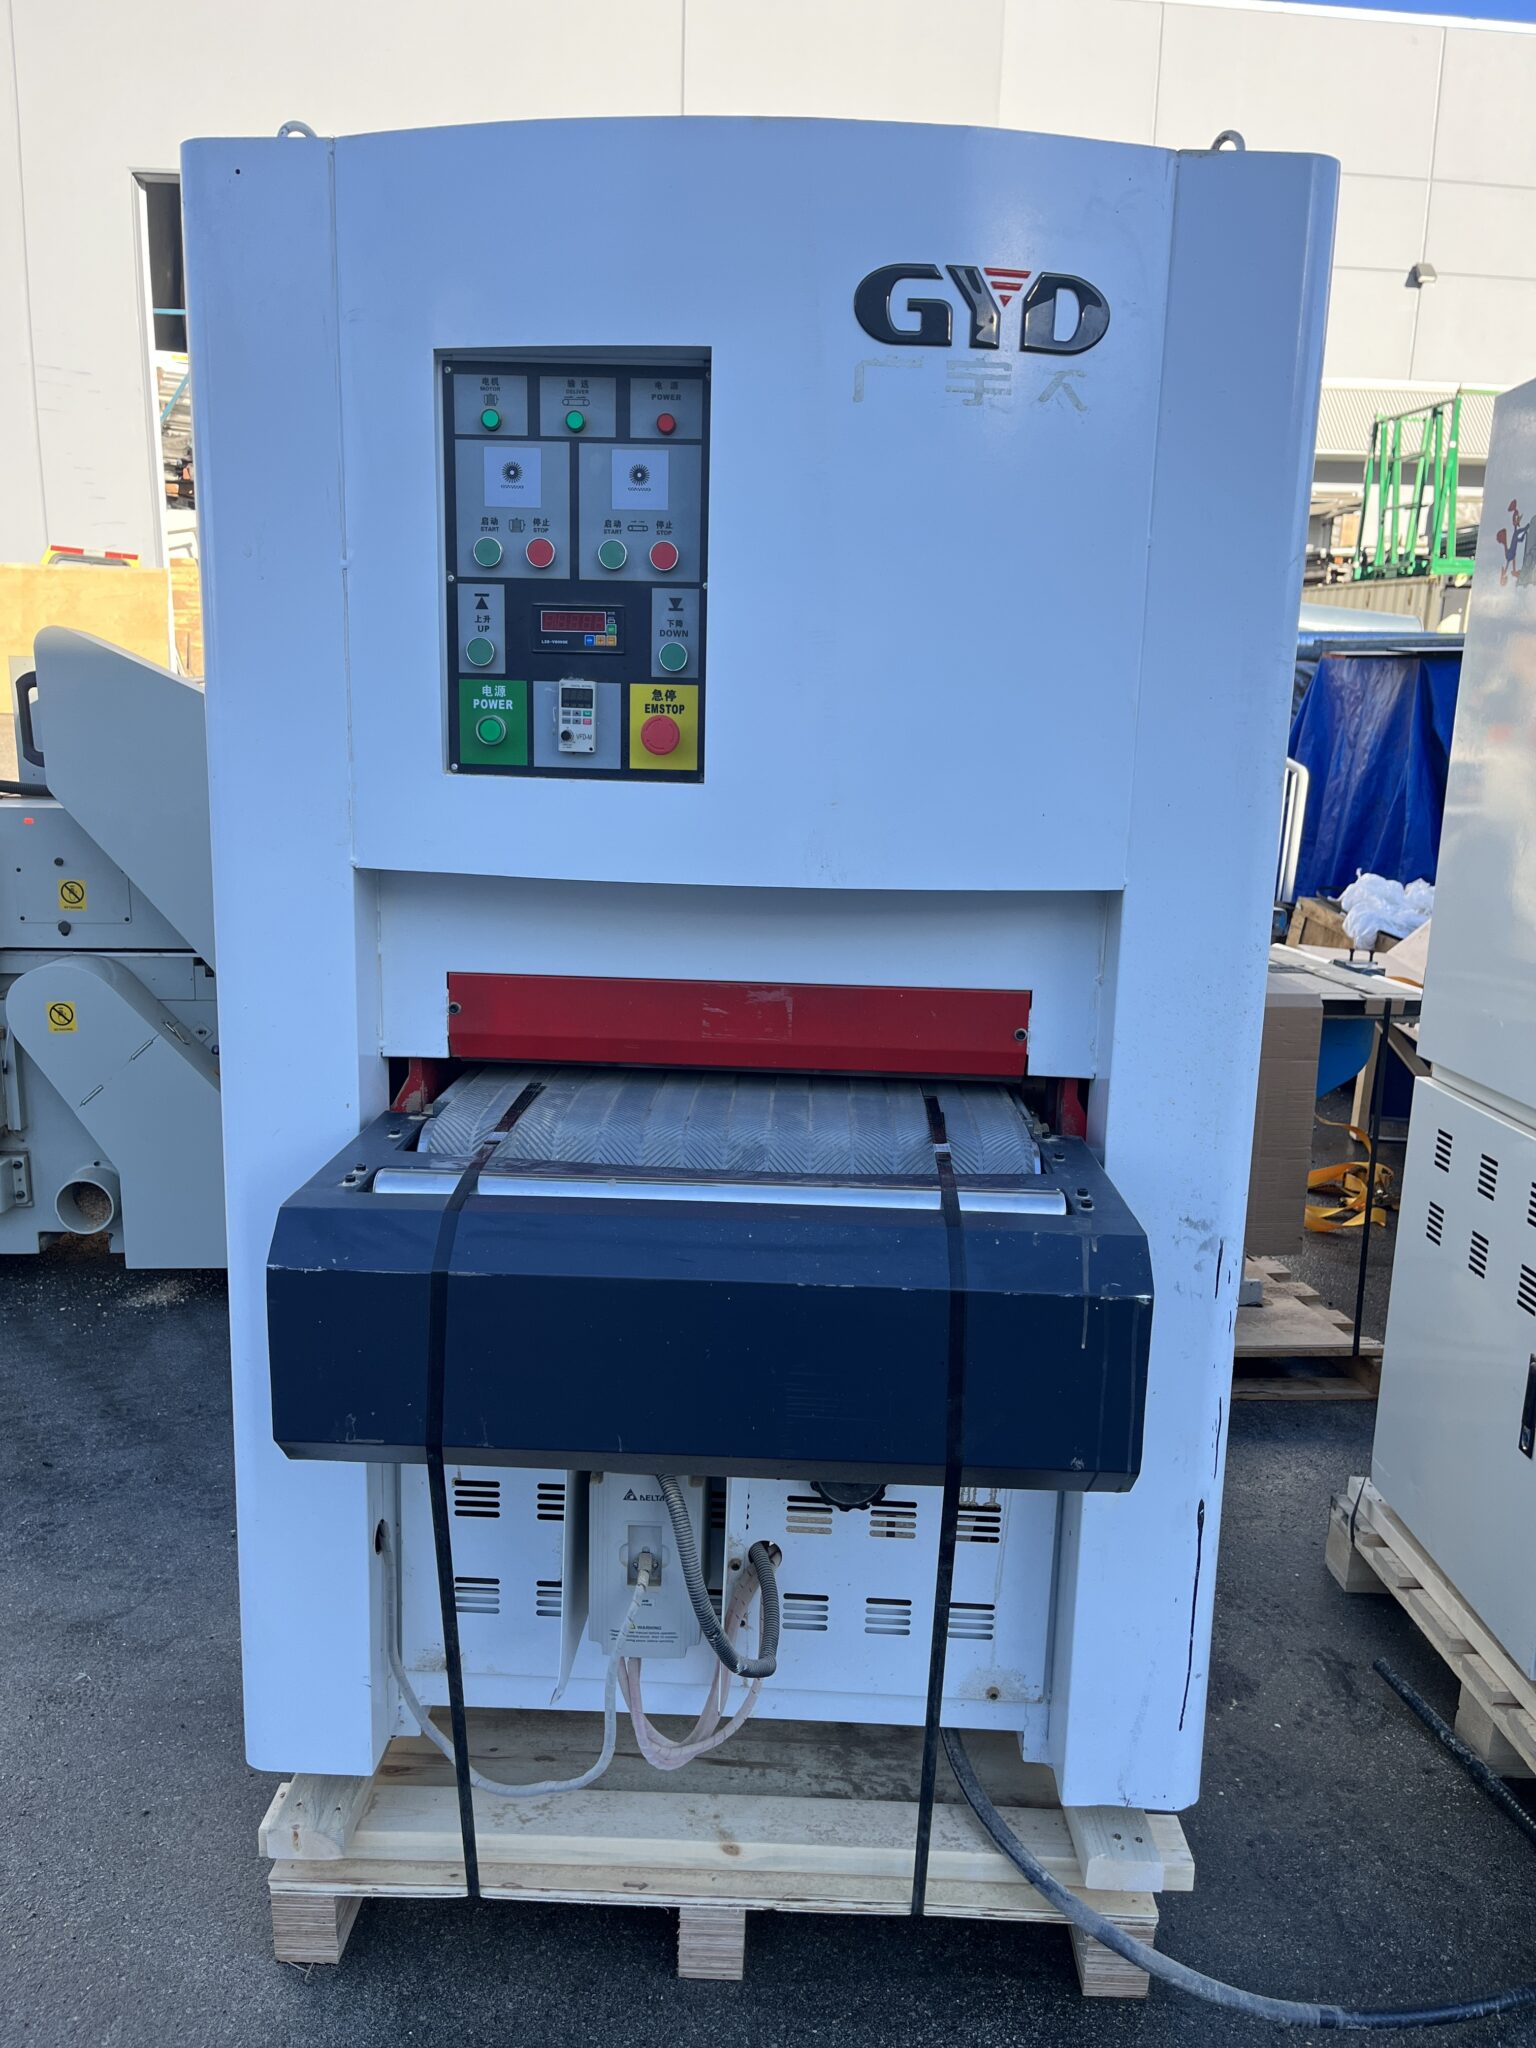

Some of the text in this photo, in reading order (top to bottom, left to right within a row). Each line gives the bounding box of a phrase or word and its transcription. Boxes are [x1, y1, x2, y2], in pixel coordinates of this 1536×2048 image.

[853, 263, 1110, 356] GYD
[481, 377, 499, 386] 电机
[481, 517, 499, 526] 启动
[533, 518, 550, 527] 停止
[604, 519, 622, 529] 启动
[656, 520, 673, 529] 停止
[474, 615, 491, 624] 上升
[667, 619, 684, 628] 下降
[477, 625, 490, 633] UP
[659, 630, 689, 638] DOWN
[482, 685, 506, 697] 电源
[652, 689, 677, 702] 急停
[473, 699, 513, 710] POWER
[644, 704, 685, 714] EMSTOP
